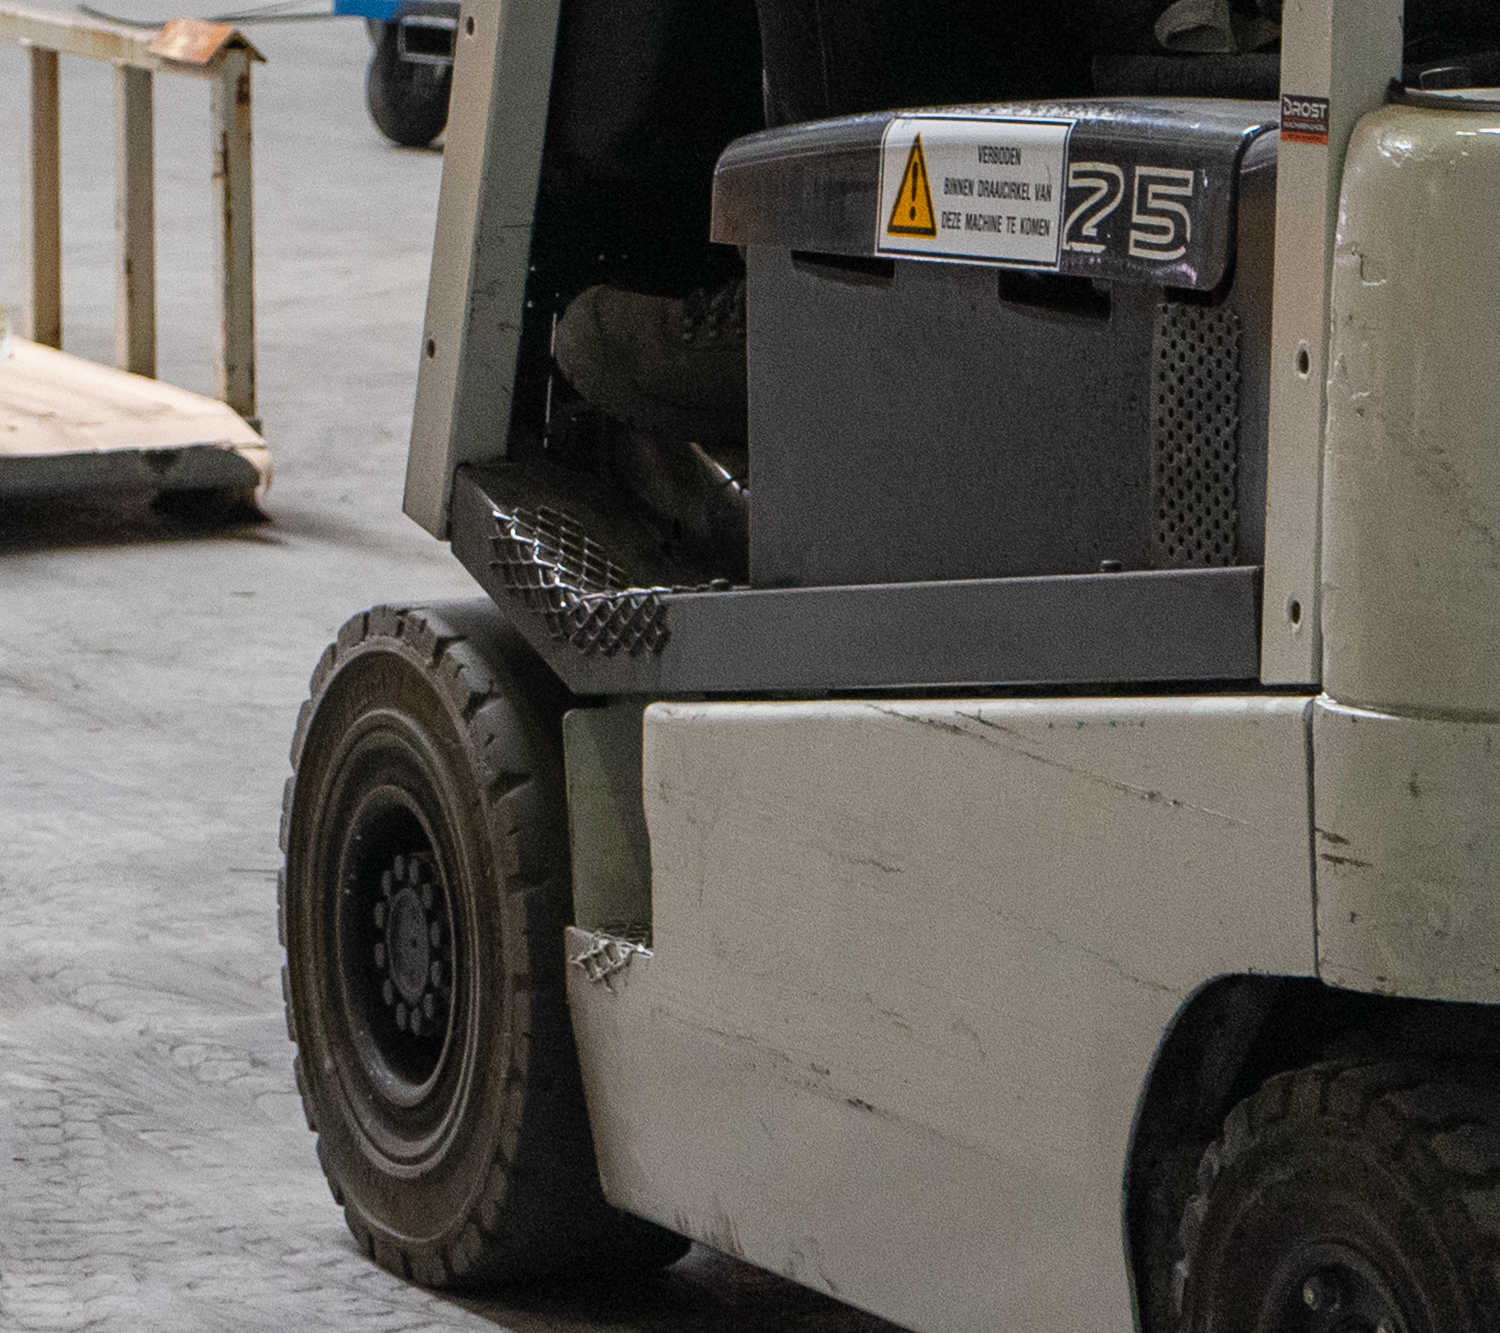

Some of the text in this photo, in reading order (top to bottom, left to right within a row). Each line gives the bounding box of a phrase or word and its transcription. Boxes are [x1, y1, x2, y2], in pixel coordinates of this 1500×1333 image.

[1283, 96, 1328, 119] DROST
[977, 144, 1022, 166] VERBODEN
[944, 177, 1052, 202] BINNEN DRAAICIRKEL VAN
[941, 210, 1050, 237] DEZE MACHINE TE KOMEN
[1062, 161, 1194, 261] 25
